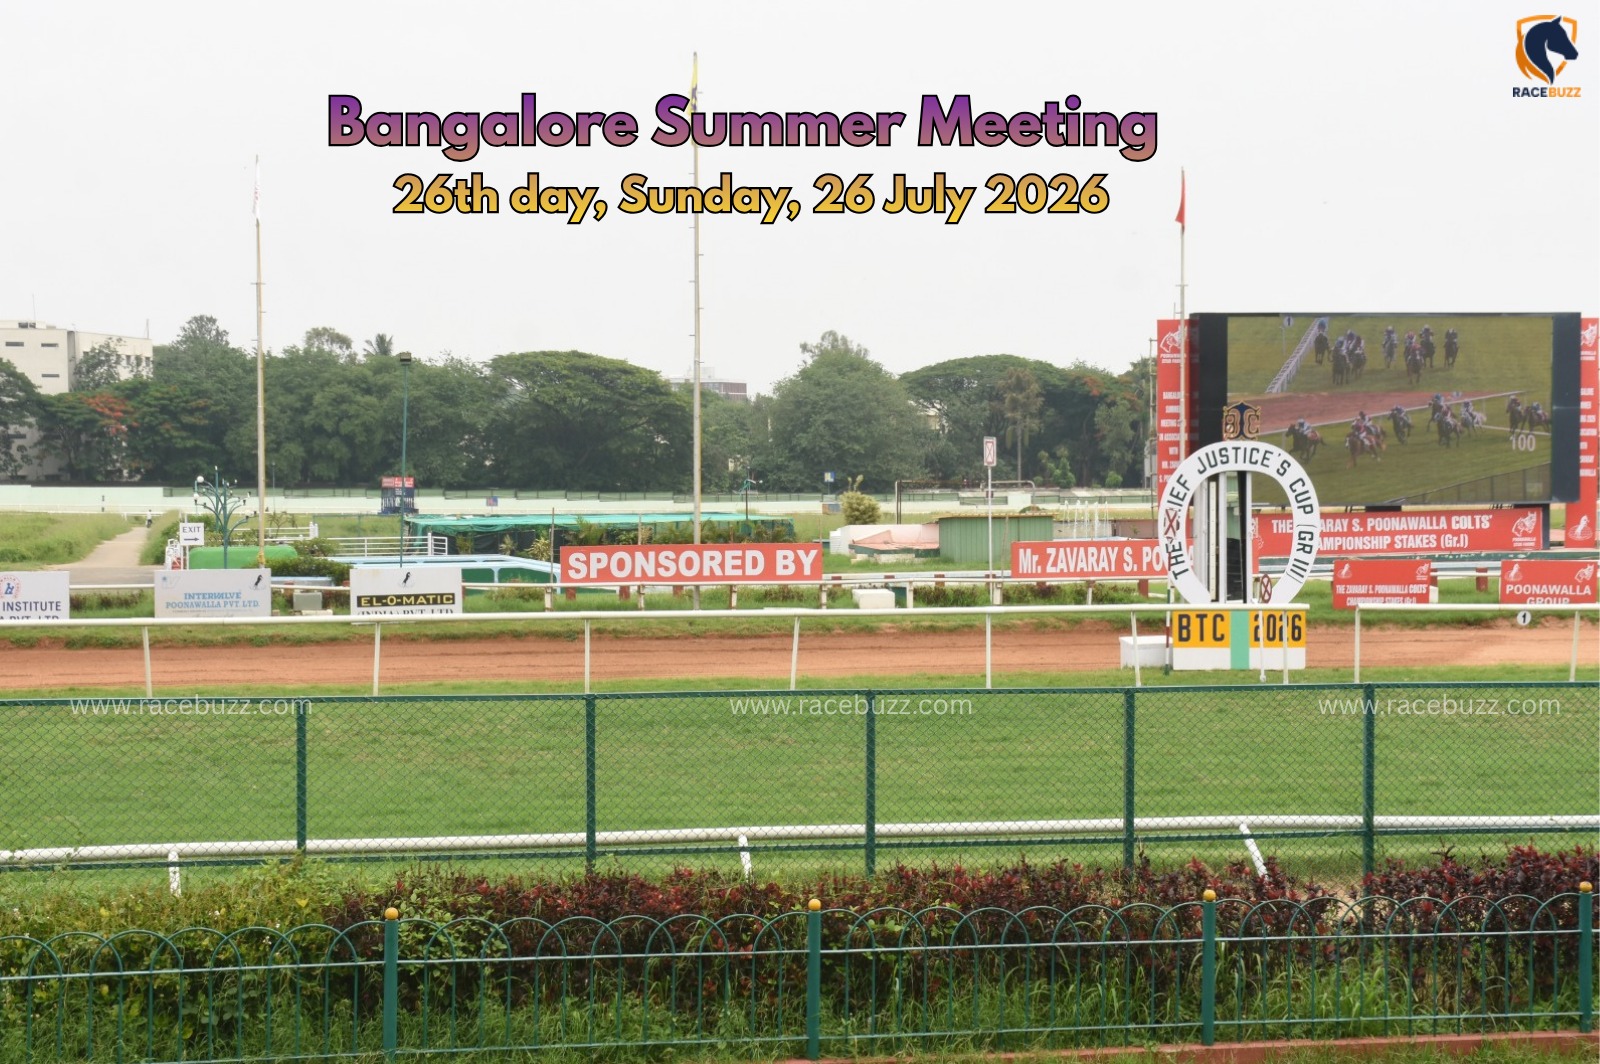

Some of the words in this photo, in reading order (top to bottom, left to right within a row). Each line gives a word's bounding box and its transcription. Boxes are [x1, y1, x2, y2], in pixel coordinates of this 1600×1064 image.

[1511, 434, 1536, 451] 100
[1197, 446, 1291, 477] JUSTICE'S
[1289, 477, 1314, 515] CUP
[182, 526, 202, 534] EXIT
[1272, 520, 1293, 533] THE
[1319, 518, 1349, 533] ARAY
[1352, 518, 1364, 532] S.
[1367, 515, 1447, 532] POONAWALLA
[1451, 514, 1493, 530] COLTS'
[1296, 524, 1317, 555] (GR
[1318, 535, 1391, 551] AMPIONSHIP
[1394, 534, 1437, 549] STAKES
[1440, 533, 1469, 549] (Gr.I)
[568, 550, 765, 580] SPONSORED
[775, 549, 818, 576] BY
[1019, 548, 1042, 573] Mr.
[1046, 546, 1118, 573] ZAVARAY
[1123, 546, 1138, 572] S.
[1165, 541, 1189, 580] THE
[1505, 584, 1591, 596] POONAWALLA
[2, 601, 62, 611] INSTITUTE
[166, 601, 221, 609] POONAWALLA
[361, 595, 453, 607] EL-O-MATIC
[1521, 612, 1527, 624] 1
[1178, 613, 1225, 642] BTC
[1254, 613, 1302, 642] 2026
